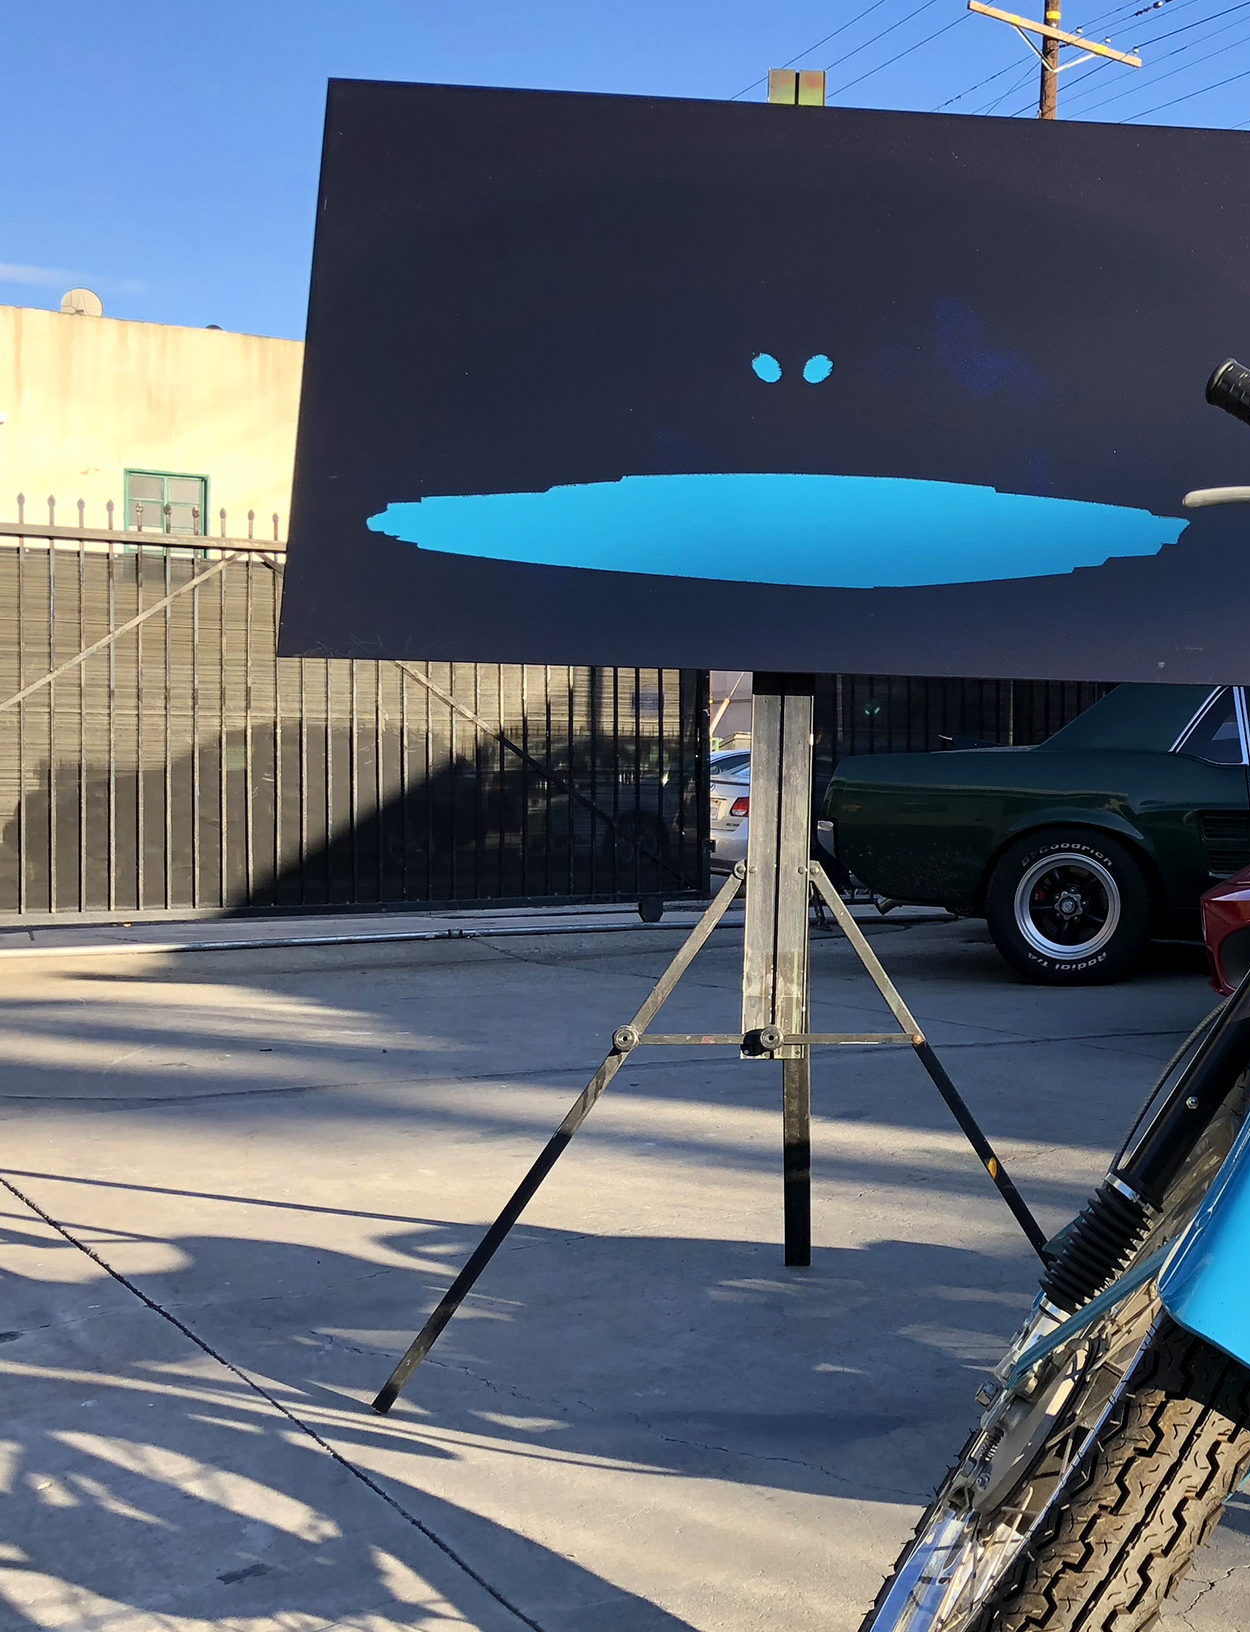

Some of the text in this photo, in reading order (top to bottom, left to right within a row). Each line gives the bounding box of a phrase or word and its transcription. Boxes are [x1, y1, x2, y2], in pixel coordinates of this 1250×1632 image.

[1021, 842, 1112, 867] BFGoodrich
[1027, 951, 1107, 970] Radial T/A
